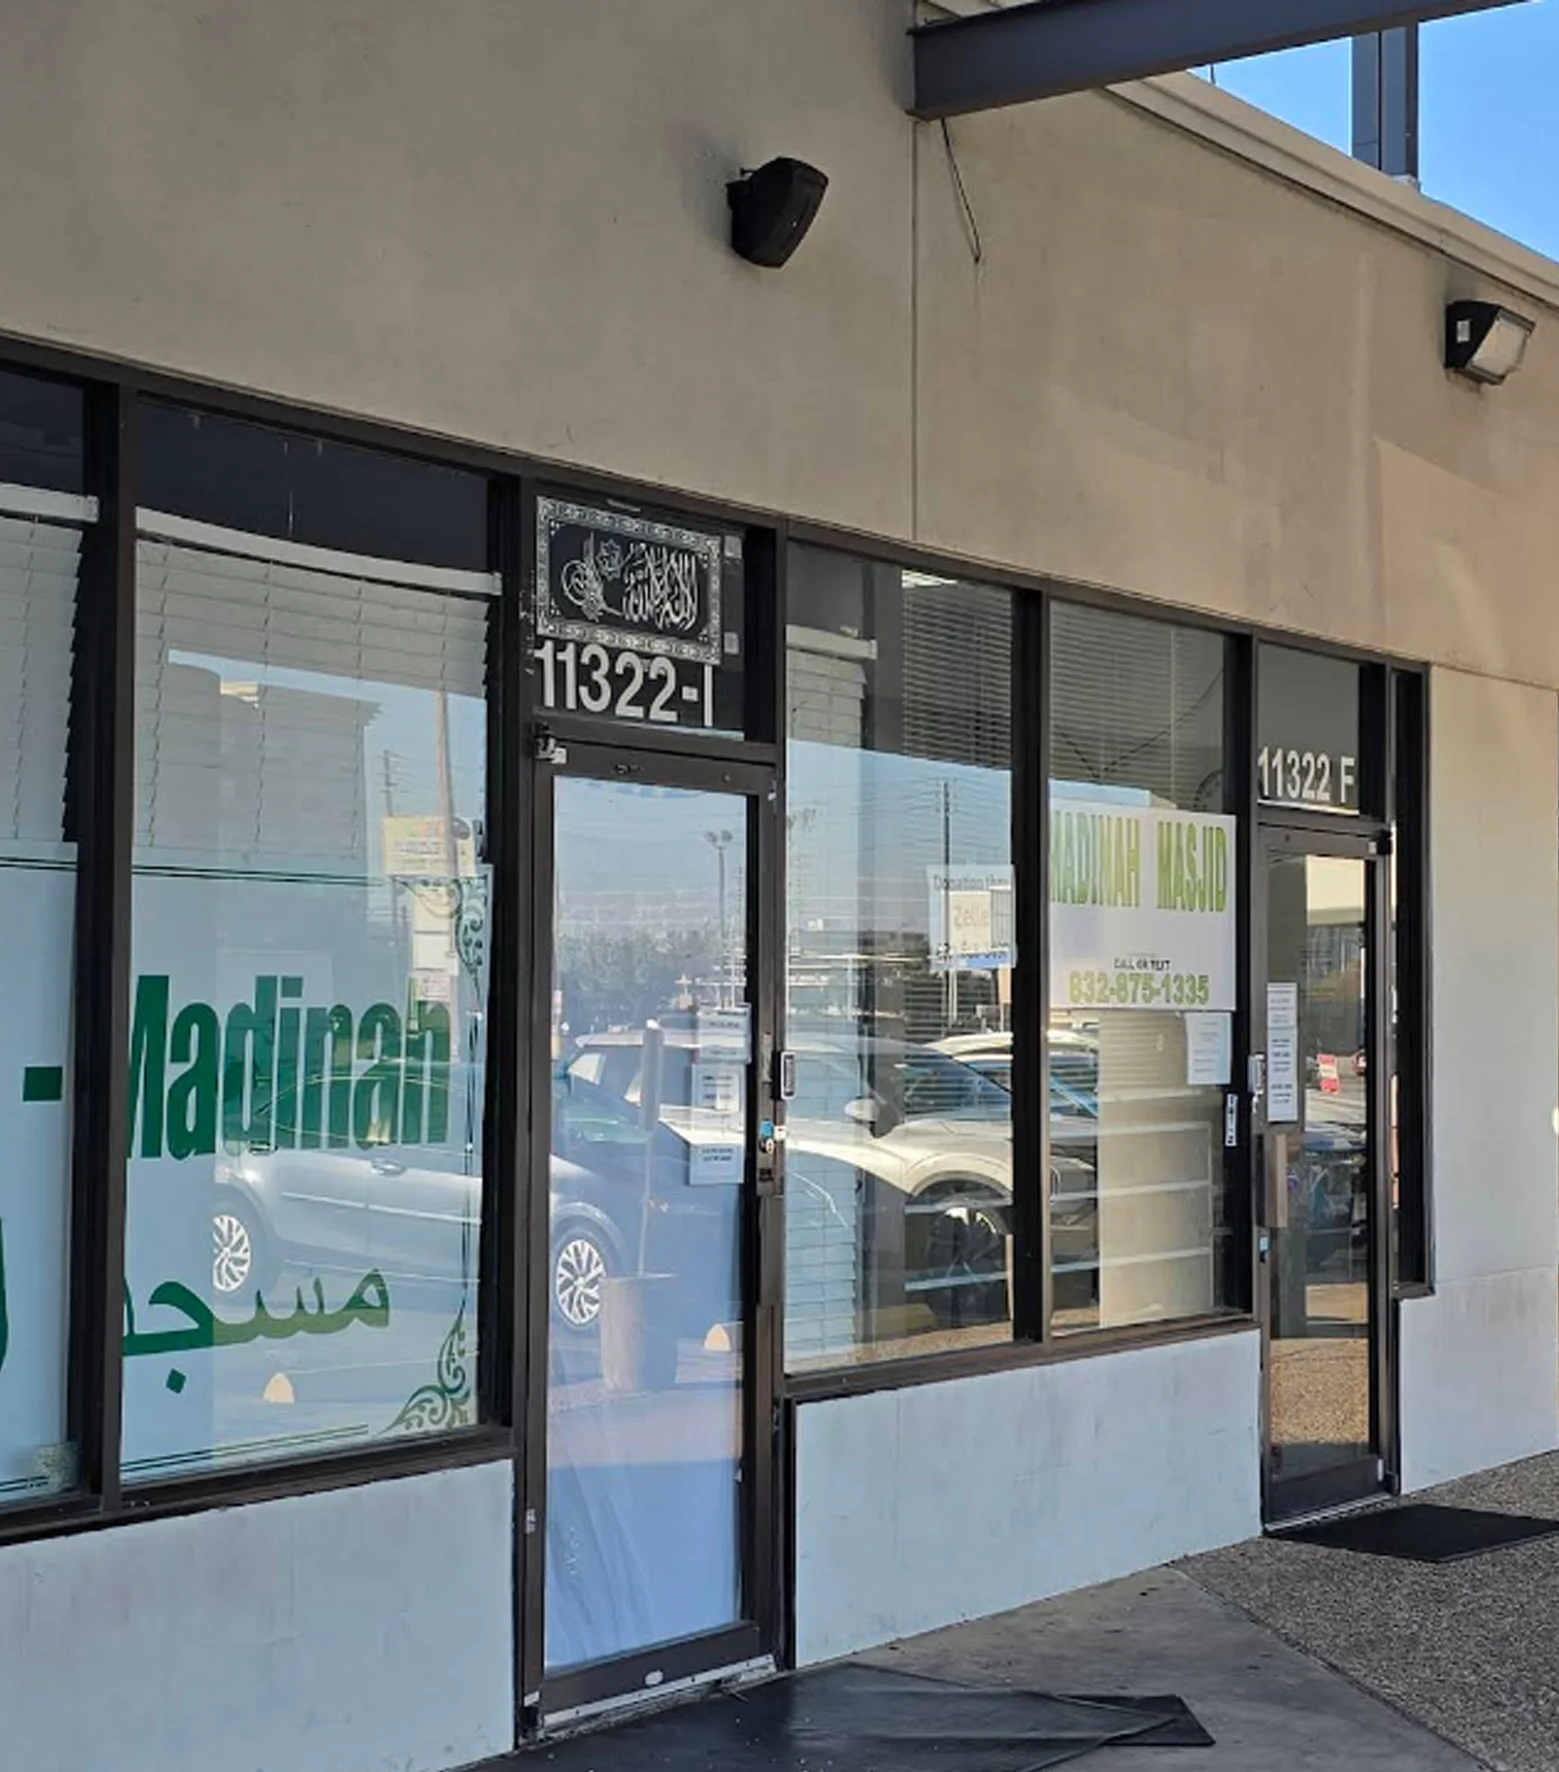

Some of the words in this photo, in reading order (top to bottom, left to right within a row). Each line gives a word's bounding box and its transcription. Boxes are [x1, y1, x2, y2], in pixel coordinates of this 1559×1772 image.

[534, 639, 713, 728] 11322-I
[1257, 746, 1331, 802] 11322
[1341, 756, 1356, 803] F
[1157, 820, 1227, 912] MASJID
[1151, 959, 1171, 971] TEXT
